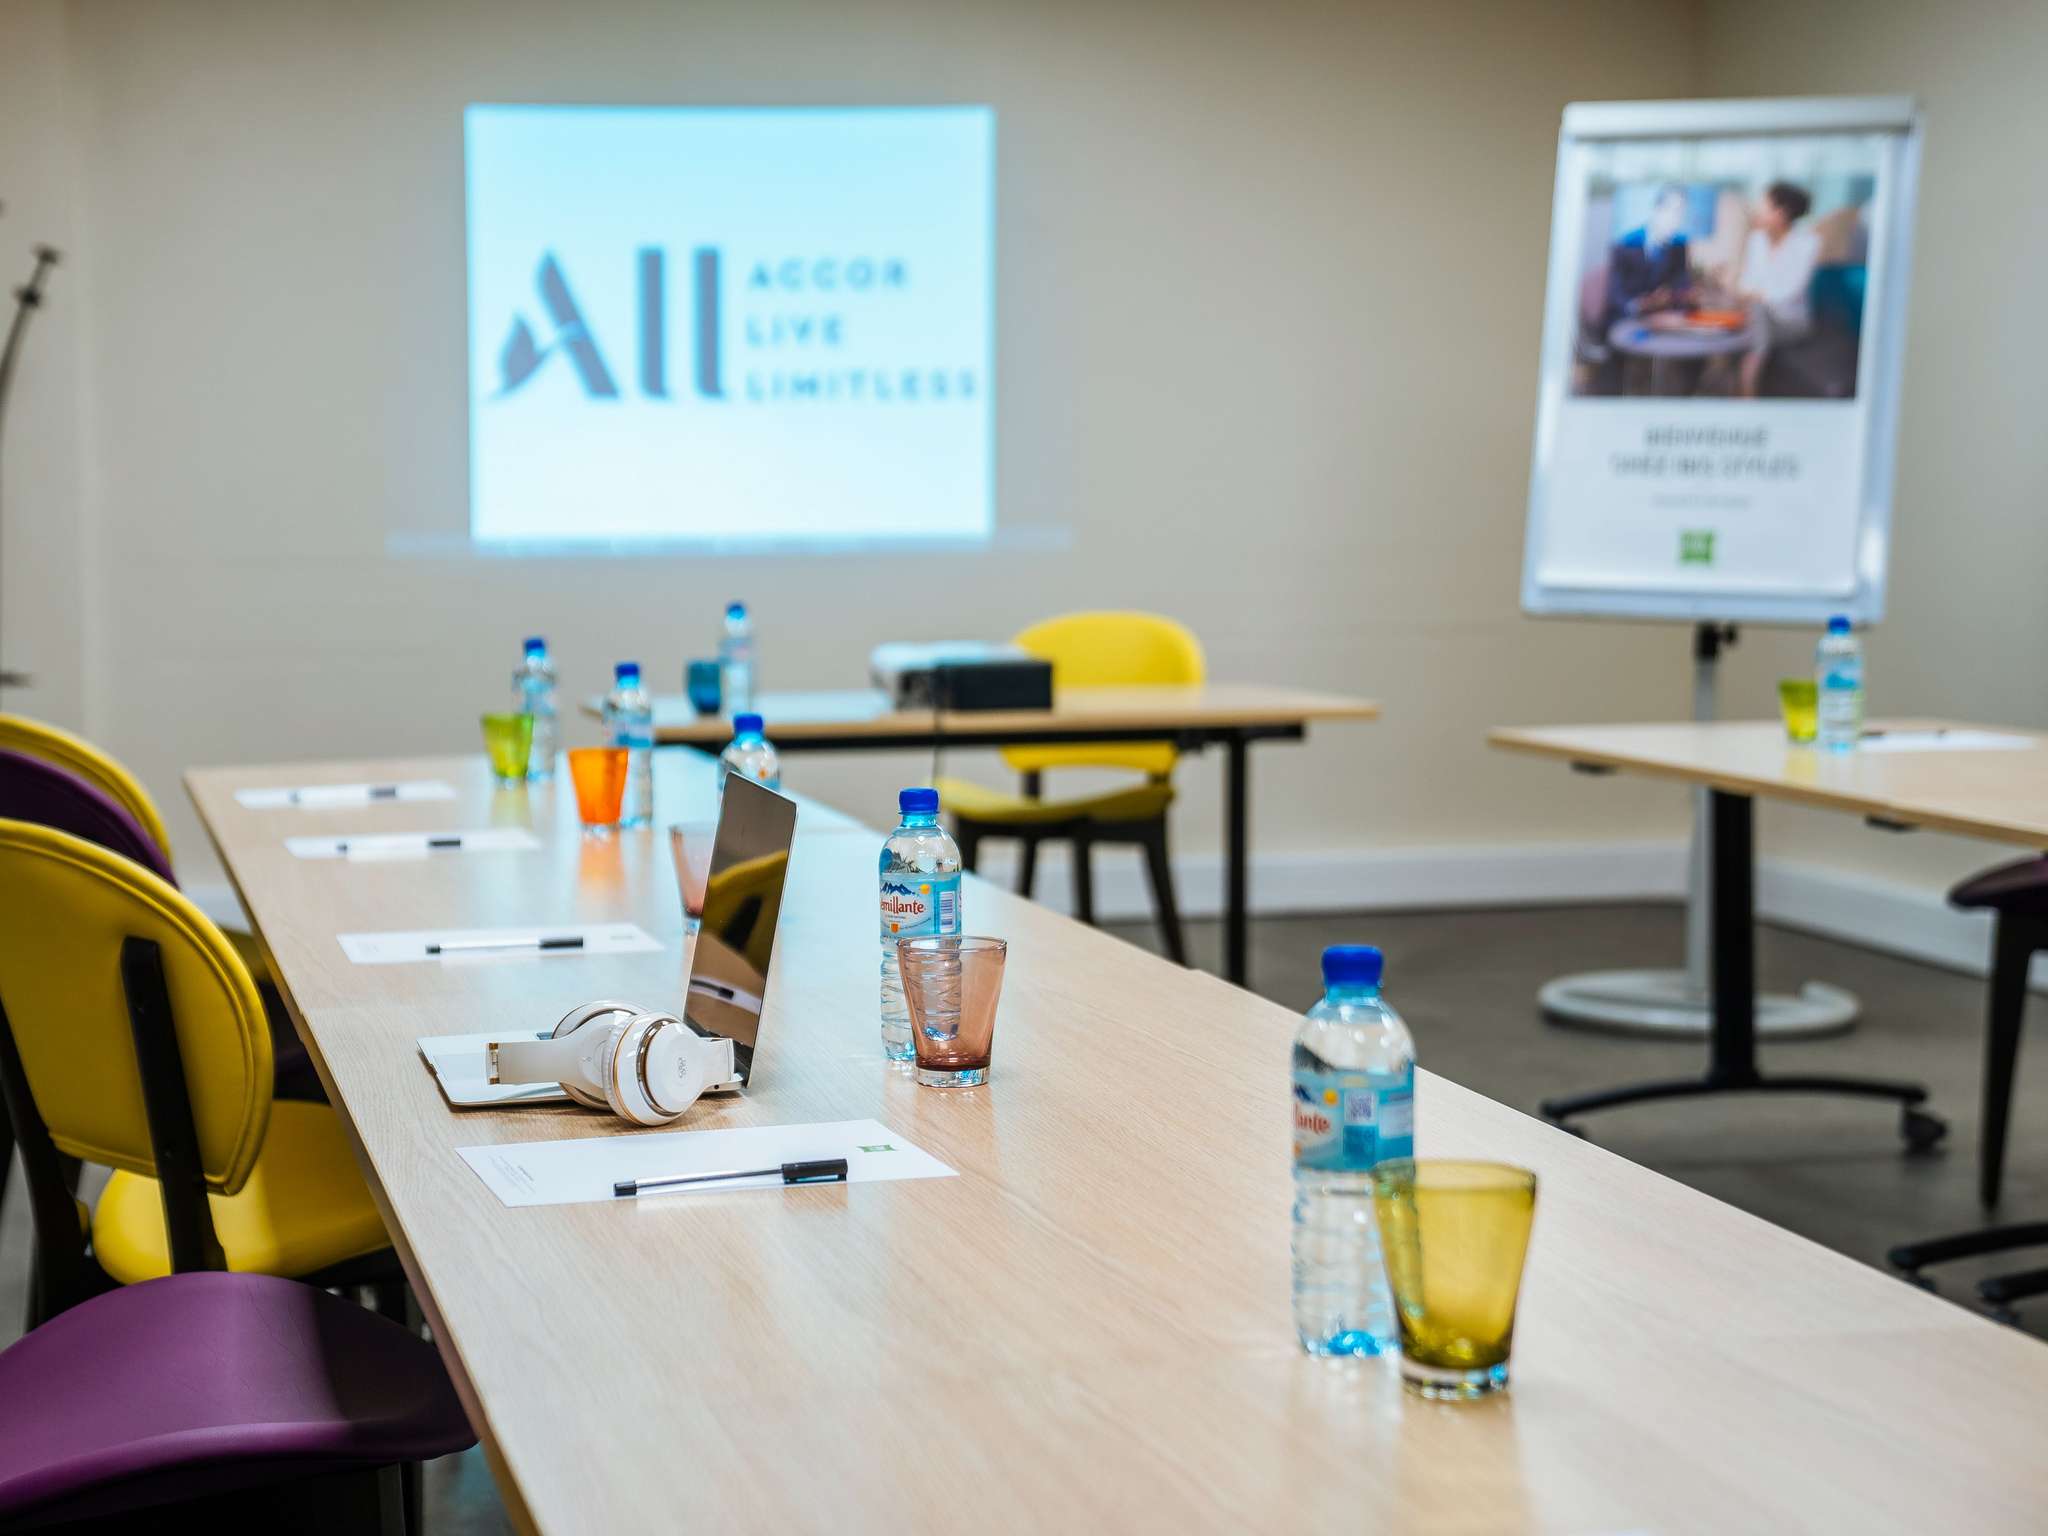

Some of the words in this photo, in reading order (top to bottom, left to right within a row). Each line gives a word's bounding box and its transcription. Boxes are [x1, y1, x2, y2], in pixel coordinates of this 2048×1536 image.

[749, 258, 908, 290] ACCOR
[746, 316, 842, 346] LIVE
[746, 369, 976, 400] LIMITLESS
